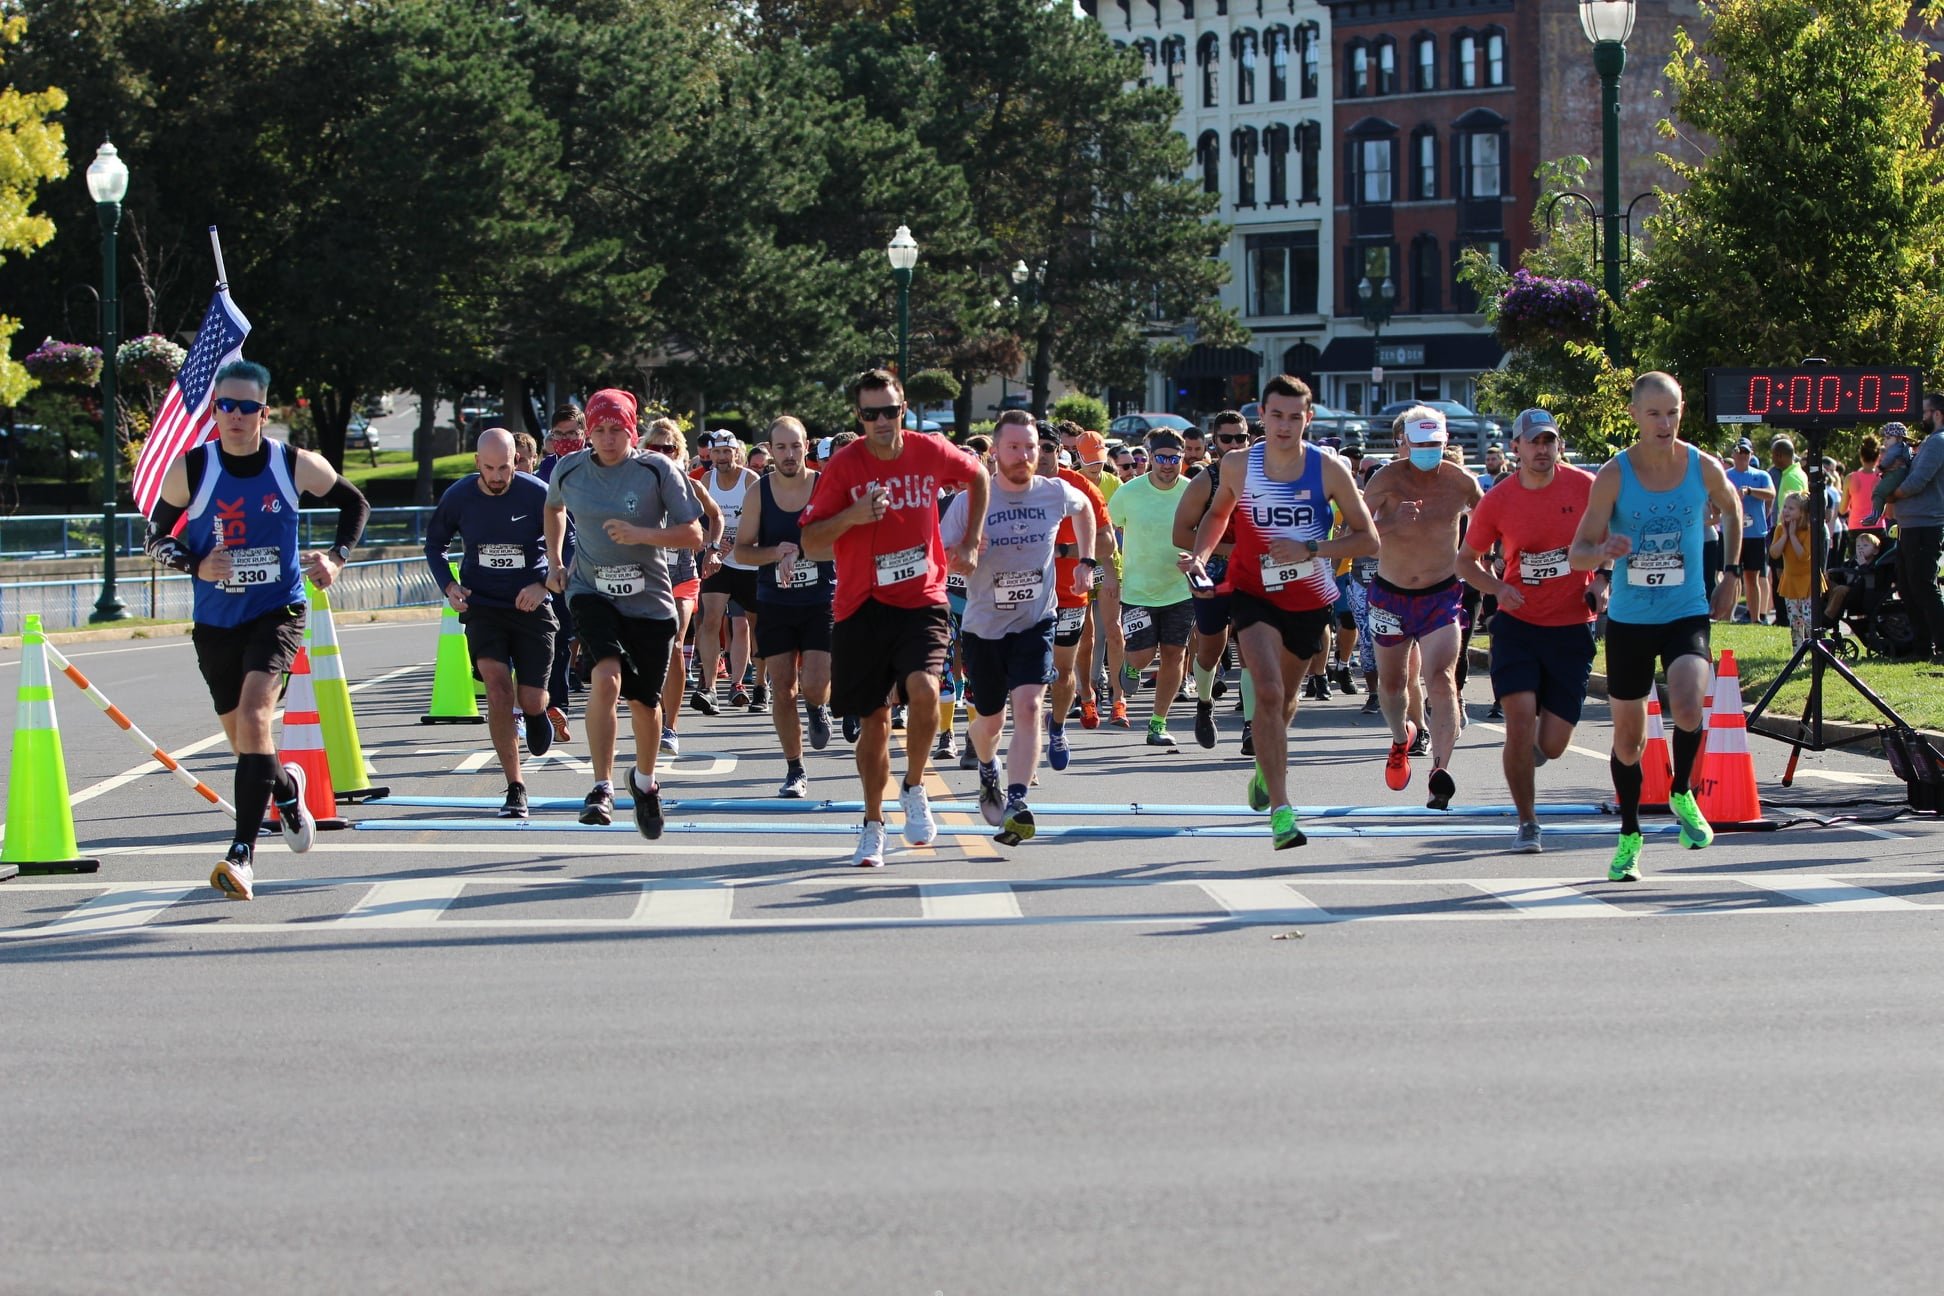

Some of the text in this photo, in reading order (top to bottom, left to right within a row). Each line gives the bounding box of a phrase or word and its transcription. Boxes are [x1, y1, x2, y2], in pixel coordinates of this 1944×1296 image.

[216, 497, 247, 546] 15K
[987, 507, 1047, 526] CRUNCH
[1252, 506, 1313, 528] USA
[991, 533, 1046, 547] HOCKEY
[490, 558, 514, 568] 392
[238, 569, 267, 583] 330
[892, 566, 916, 581] 115
[1279, 568, 1298, 581] 89
[1532, 567, 1558, 578] 279
[1646, 573, 1666, 585] 67
[607, 583, 633, 594] 410
[1008, 588, 1034, 601] 262
[1127, 620, 1144, 632] 190
[1375, 623, 1388, 634] 43
